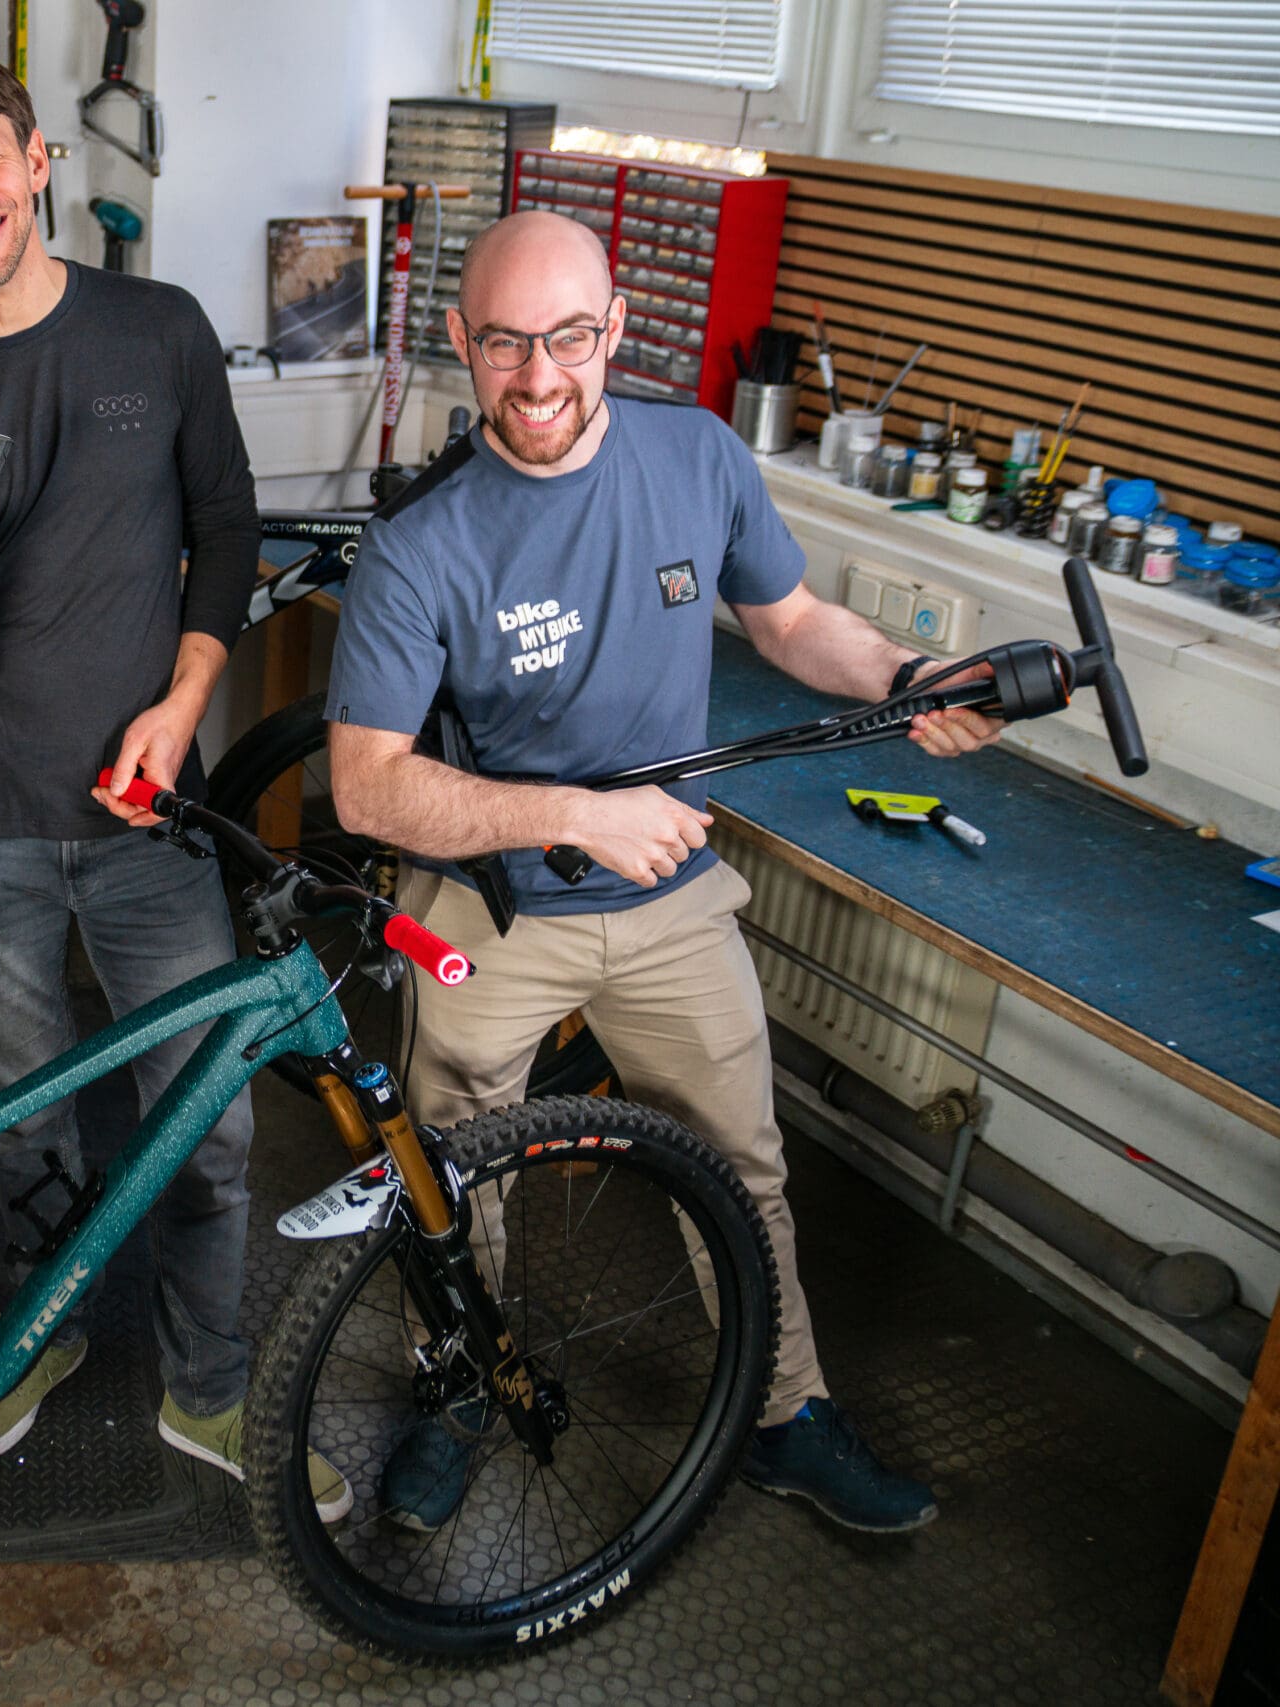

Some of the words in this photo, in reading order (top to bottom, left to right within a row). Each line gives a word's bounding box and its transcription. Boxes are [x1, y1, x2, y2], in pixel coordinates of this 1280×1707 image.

[383, 271, 410, 426] RENNKOMPRESSOR
[261, 522, 311, 533] ACTORY
[311, 523, 363, 535] RACING
[497, 599, 561, 632] bike
[546, 609, 583, 643] BIKE
[297, 1211, 319, 1232] GOOD
[311, 1204, 331, 1223] FUN
[14, 1258, 90, 1352] TREK
[516, 1567, 631, 1643] MAXXIS
